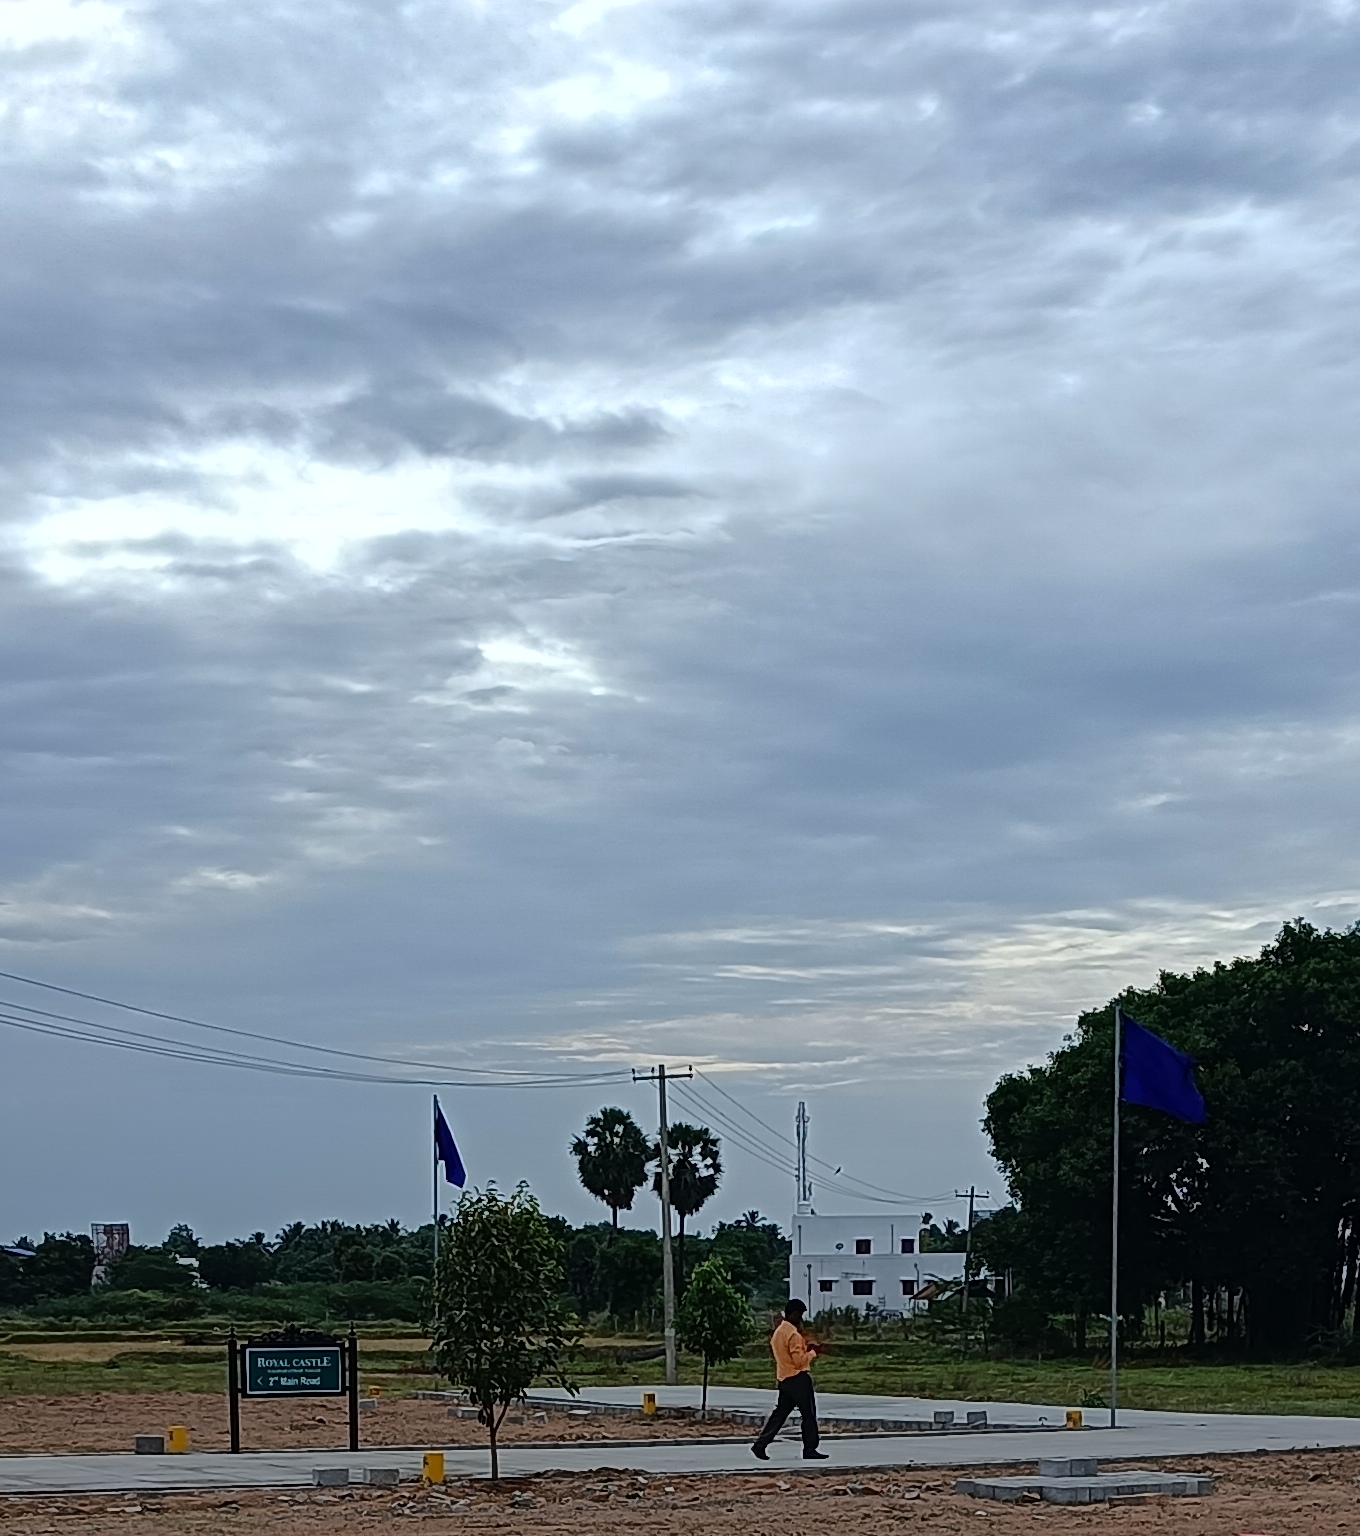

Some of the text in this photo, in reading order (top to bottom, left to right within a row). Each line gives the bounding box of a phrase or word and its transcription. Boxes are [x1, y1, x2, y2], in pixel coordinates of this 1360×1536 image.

[257, 1357, 331, 1367] ROYAL CASTLE
[280, 1377, 298, 1385] Main
[300, 1377, 321, 1385] Road
